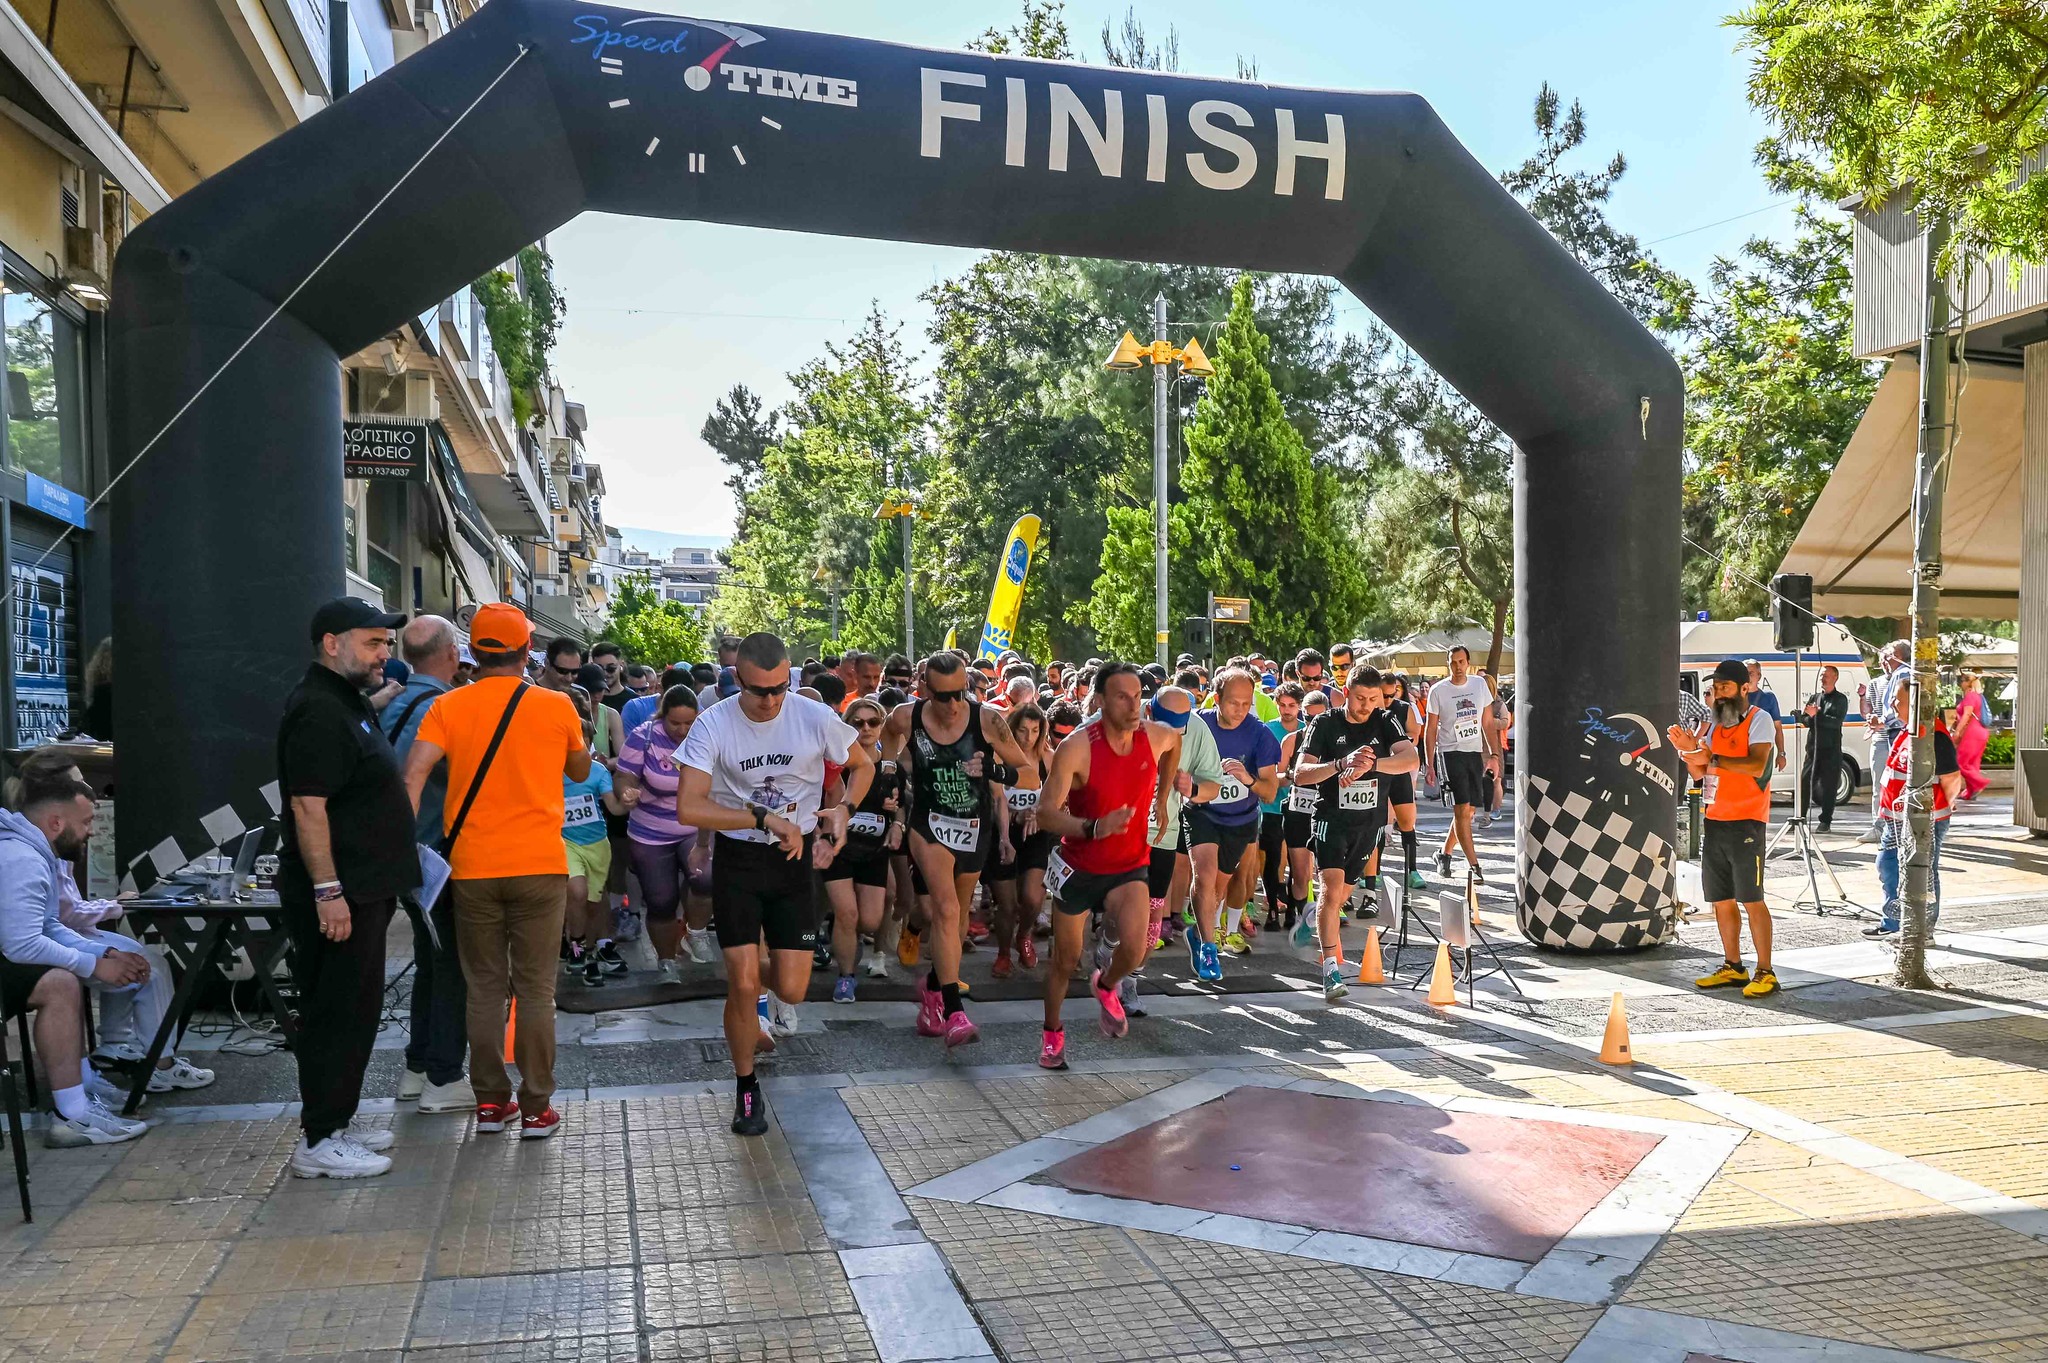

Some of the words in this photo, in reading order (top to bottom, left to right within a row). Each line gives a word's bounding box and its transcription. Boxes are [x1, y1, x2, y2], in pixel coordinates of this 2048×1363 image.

[570, 15, 689, 59] Speed
[720, 63, 858, 108] TIME
[920, 67, 1346, 200] FINISH
[345, 443, 411, 460] ΓΡΑΦΕΙΟ
[357, 466, 373, 475] 210
[375, 467, 410, 477] 9374037
[1458, 726, 1478, 738] 1296
[1578, 707, 1635, 744] Speed
[739, 755, 764, 772] TALK
[766, 753, 793, 766] NOW
[932, 767, 967, 781] THE
[1635, 756, 1675, 796] TIME
[933, 781, 971, 792] OTHER
[940, 790, 970, 804] SIDE
[1008, 792, 1037, 807] 459
[1344, 791, 1375, 804] 1402
[565, 806, 593, 822] 238
[935, 827, 973, 845] 0172
